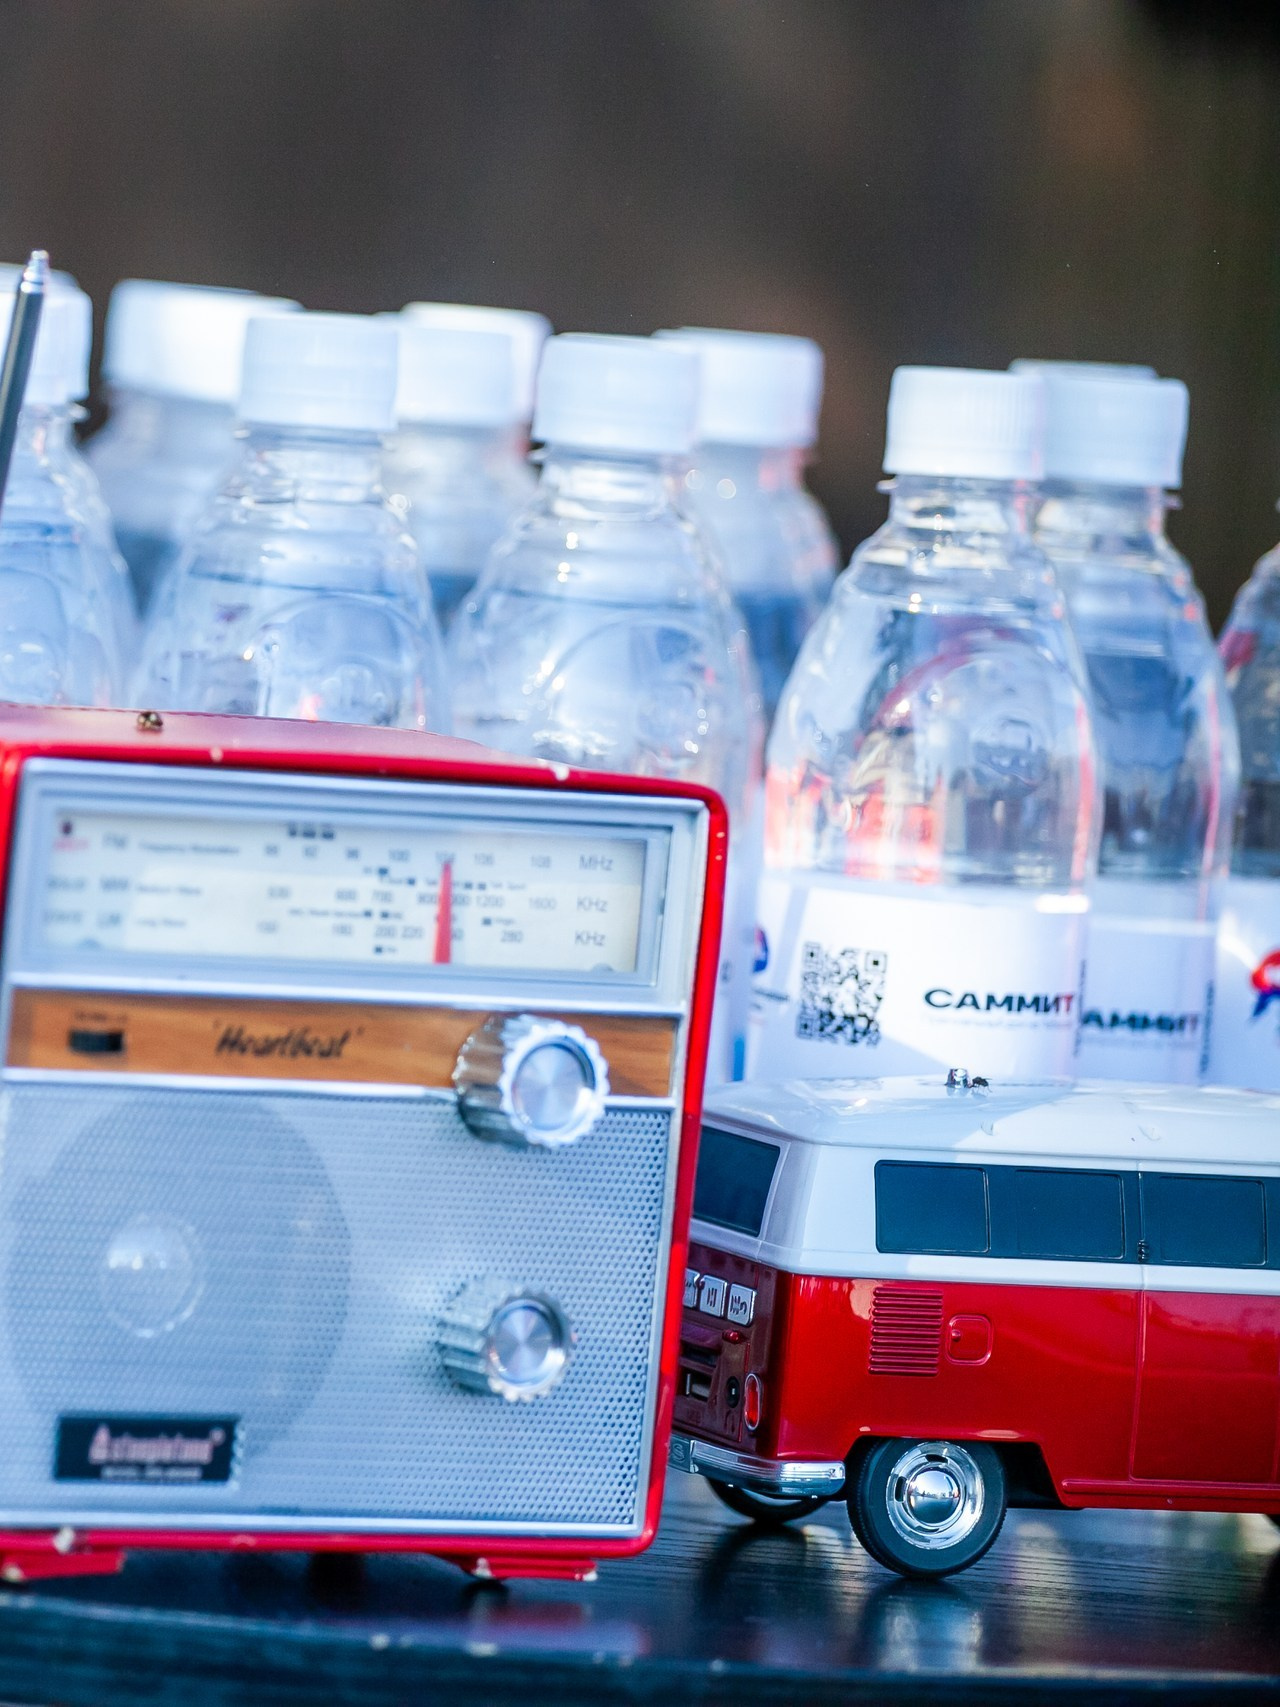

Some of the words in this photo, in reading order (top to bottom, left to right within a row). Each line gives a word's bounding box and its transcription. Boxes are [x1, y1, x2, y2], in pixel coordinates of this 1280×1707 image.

[579, 855, 613, 871] MHz
[577, 896, 608, 912] KHz
[575, 931, 606, 946] KHz
[925, 989, 1074, 1014] САММИТ
